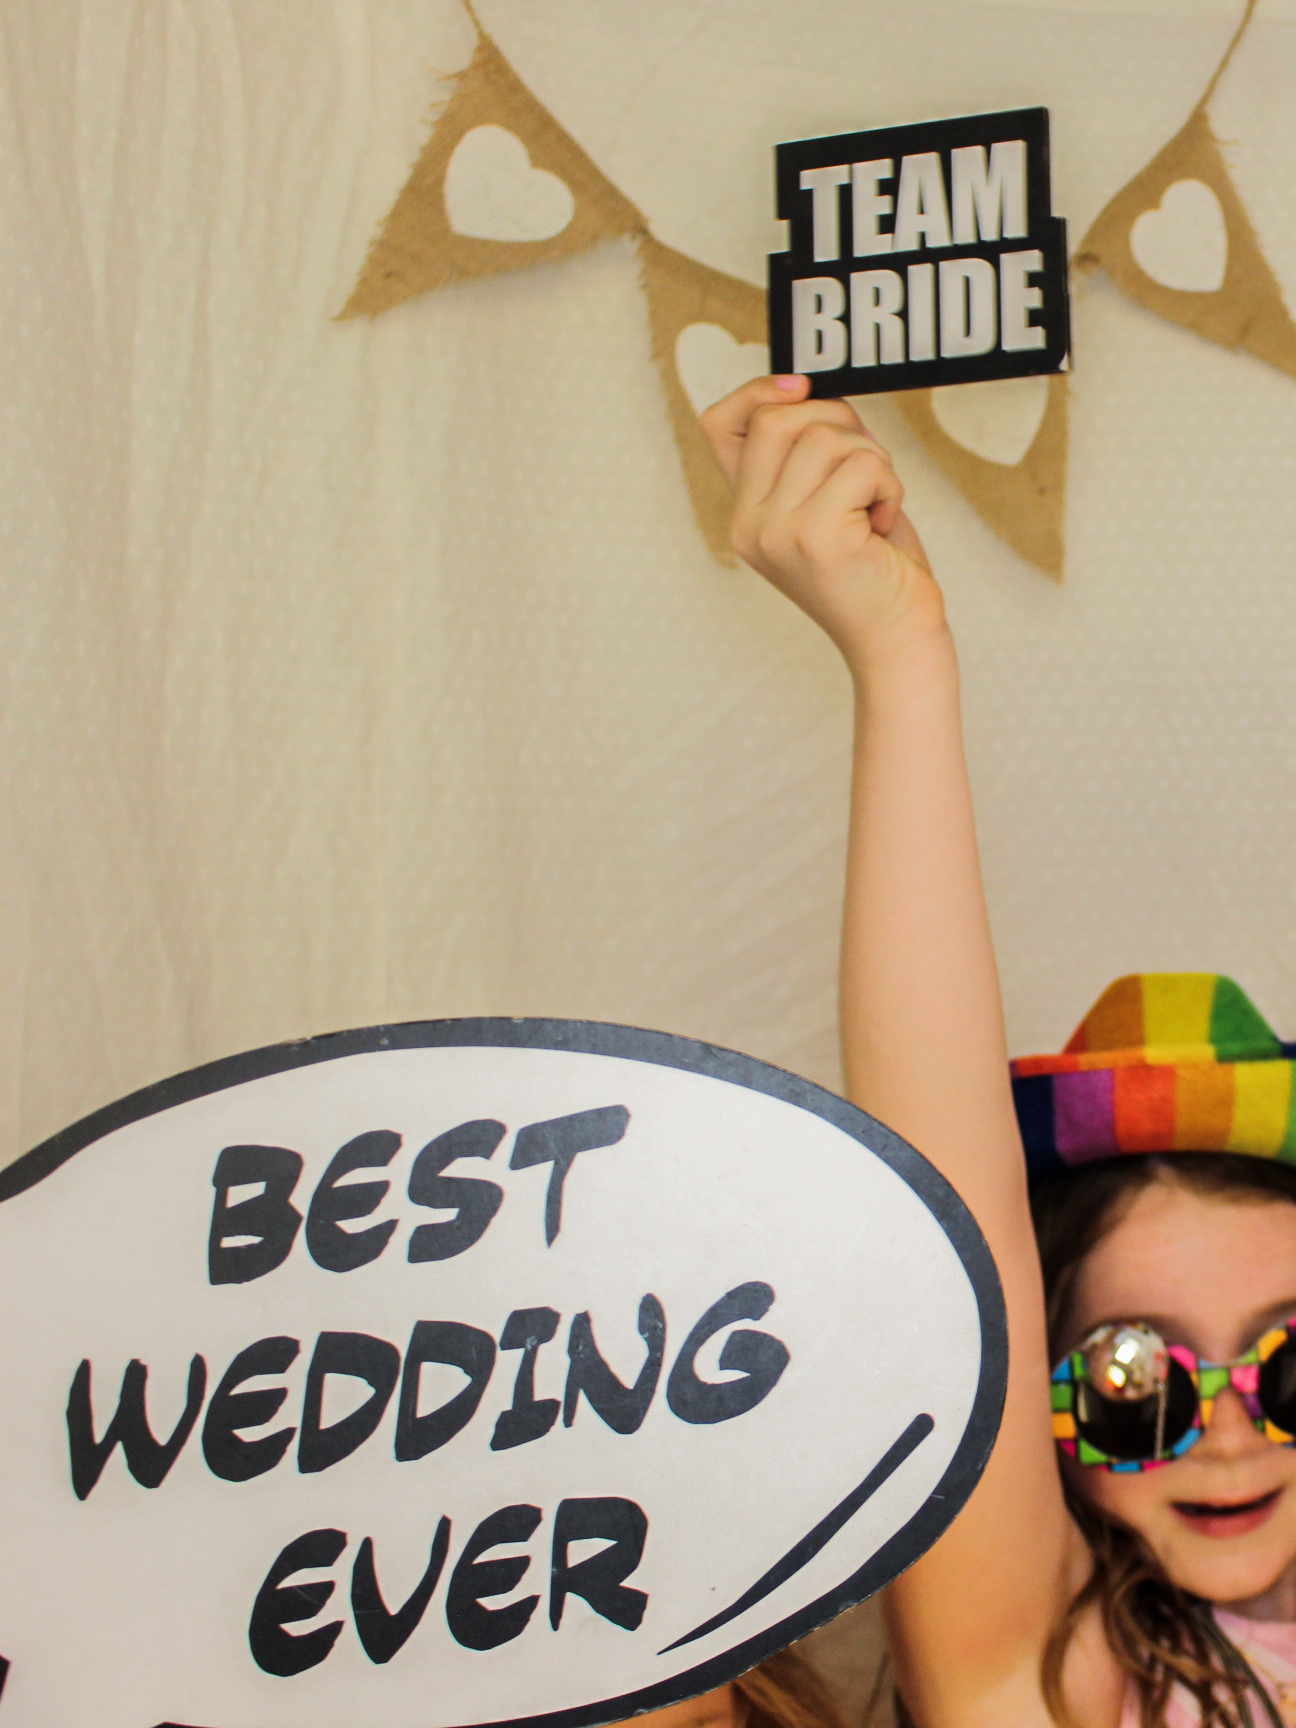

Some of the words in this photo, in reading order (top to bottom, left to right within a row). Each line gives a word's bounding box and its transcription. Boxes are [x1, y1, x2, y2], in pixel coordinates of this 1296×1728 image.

[800, 139, 1028, 263] TEAM
[792, 249, 1046, 375] BRIDE
[208, 1104, 630, 1285] BEST
[65, 1281, 791, 1501] WEDDING
[248, 1497, 649, 1677] EVER
